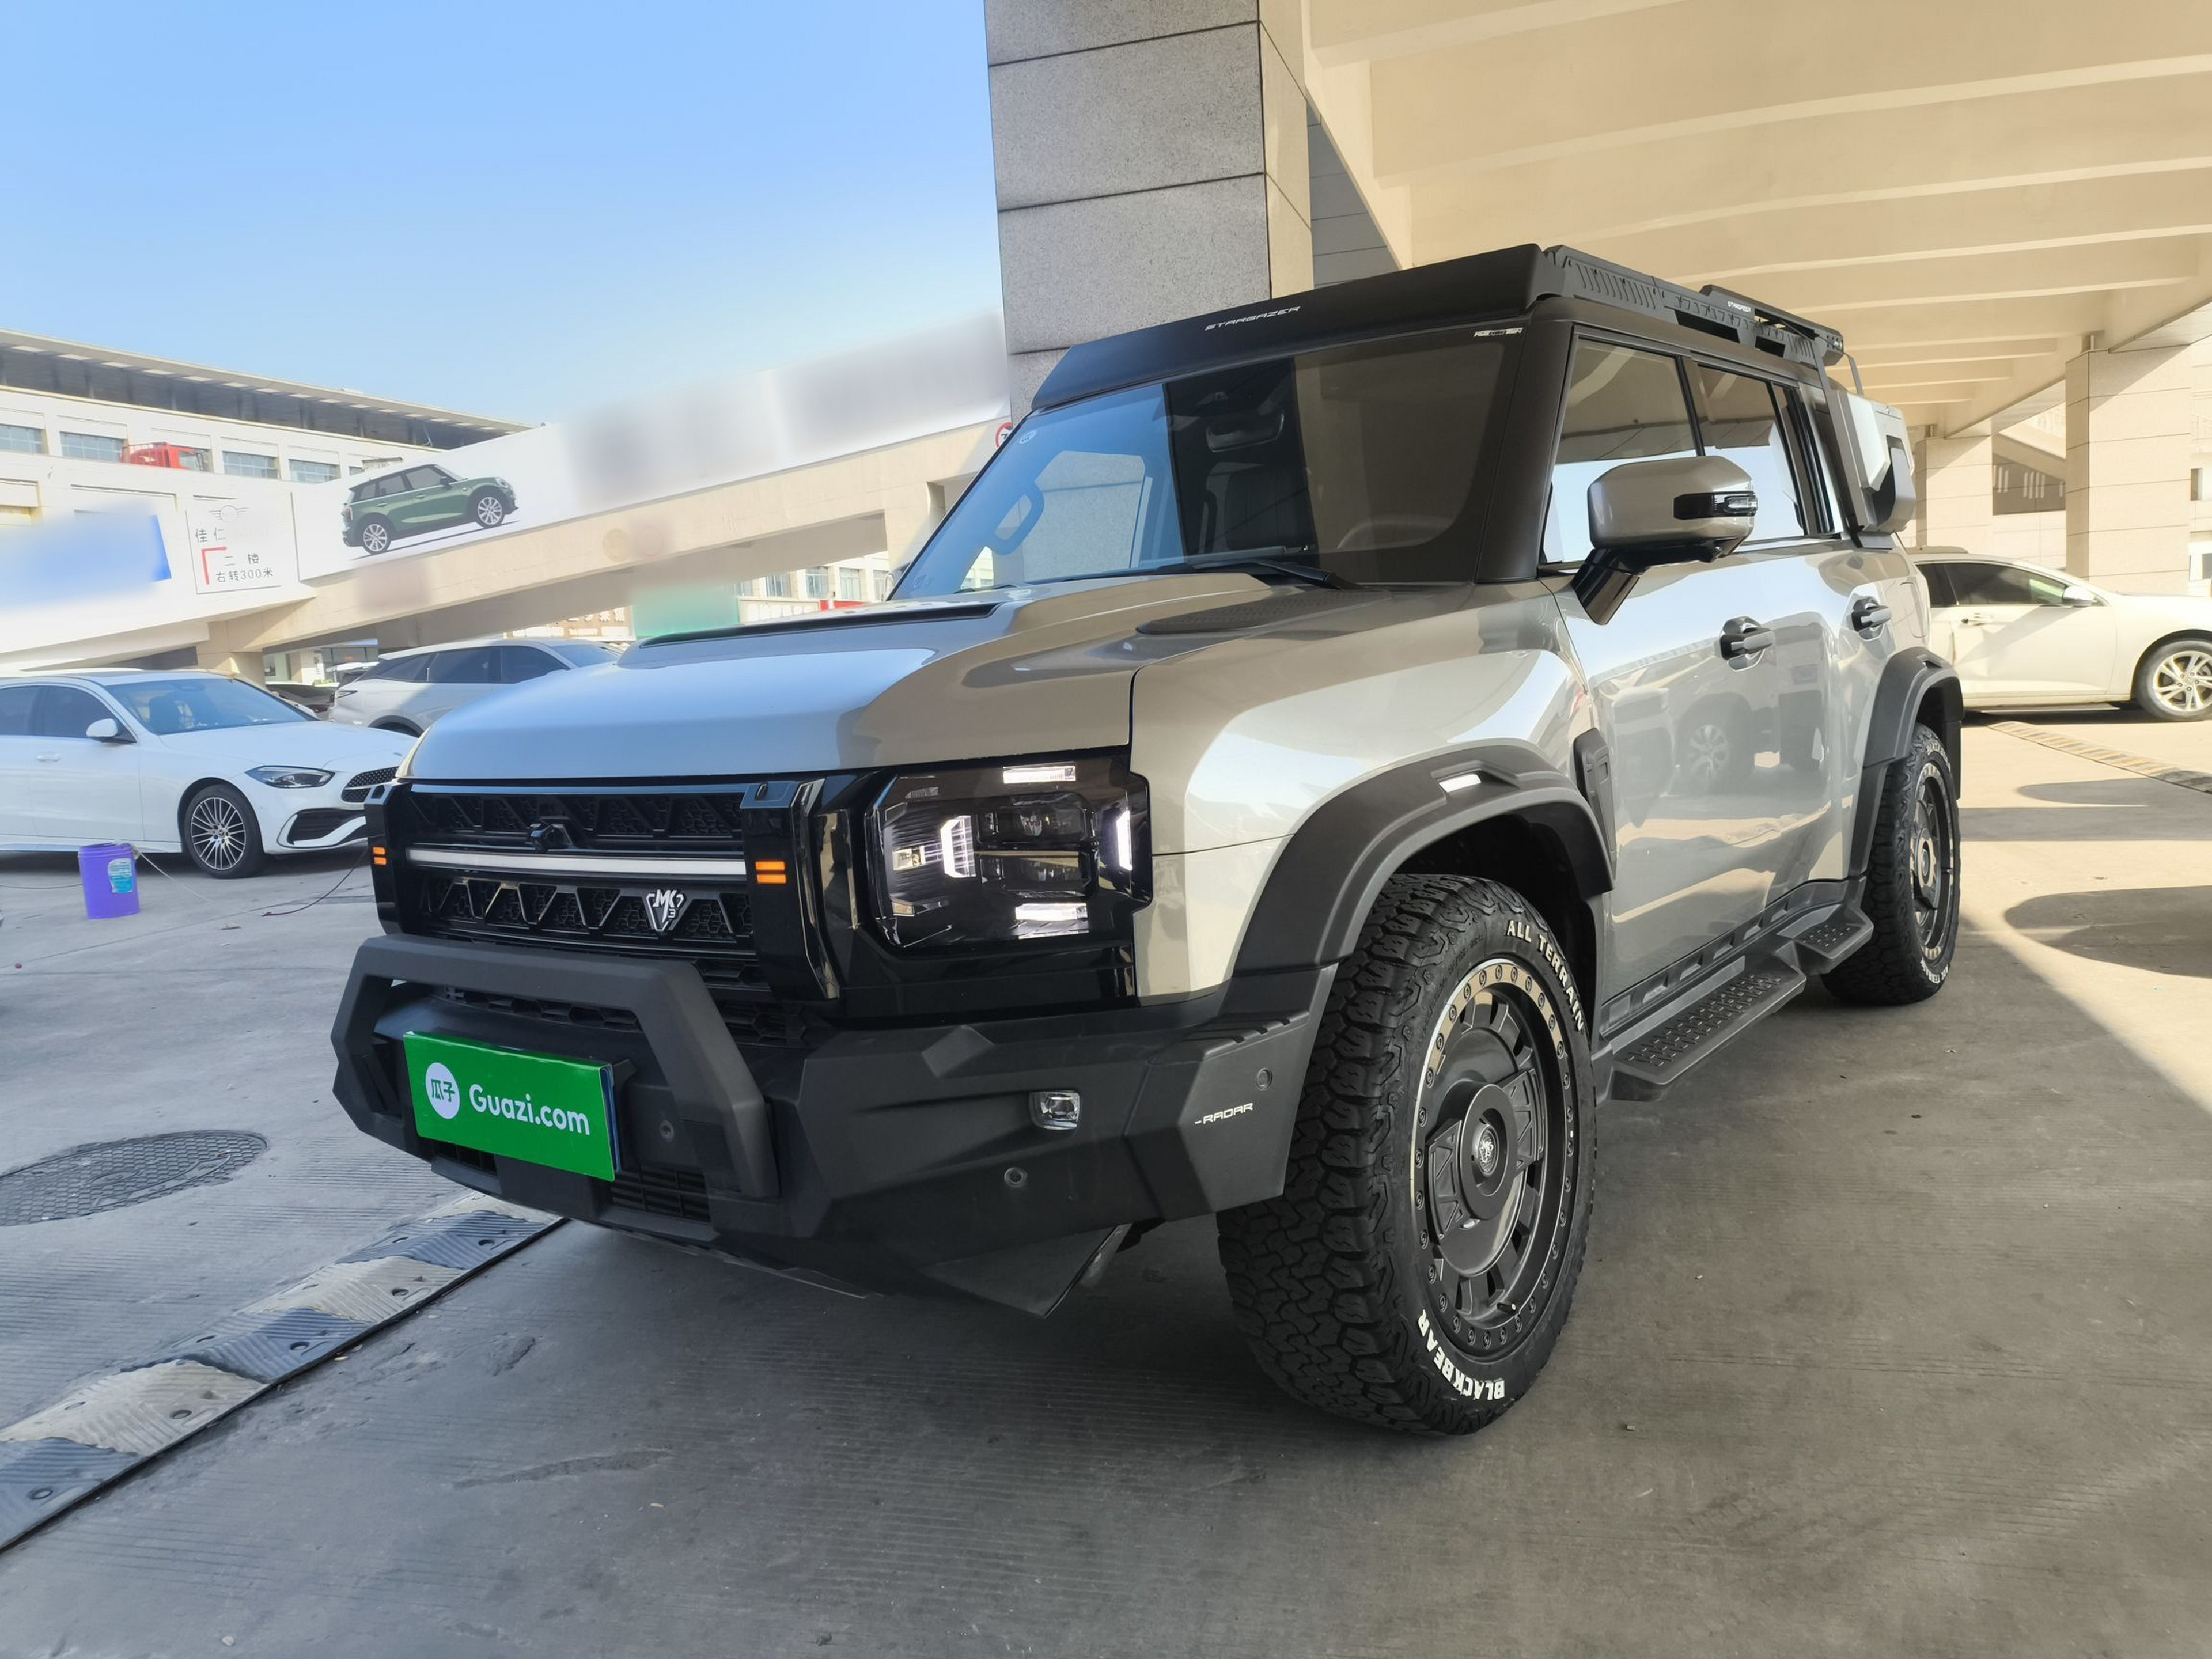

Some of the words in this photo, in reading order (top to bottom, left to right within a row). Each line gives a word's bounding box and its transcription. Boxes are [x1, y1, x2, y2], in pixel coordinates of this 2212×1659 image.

[1205, 306, 1301, 331] STARGAZER
[215, 567, 274, 583] 右转300米
[1507, 920, 1532, 943] ALL
[1539, 934, 1584, 1031] TERRAIN
[431, 1078, 455, 1102] 瓜子
[469, 1084, 590, 1135] Guazi.com
[1418, 1309, 1505, 1400] BLACKBEAR
